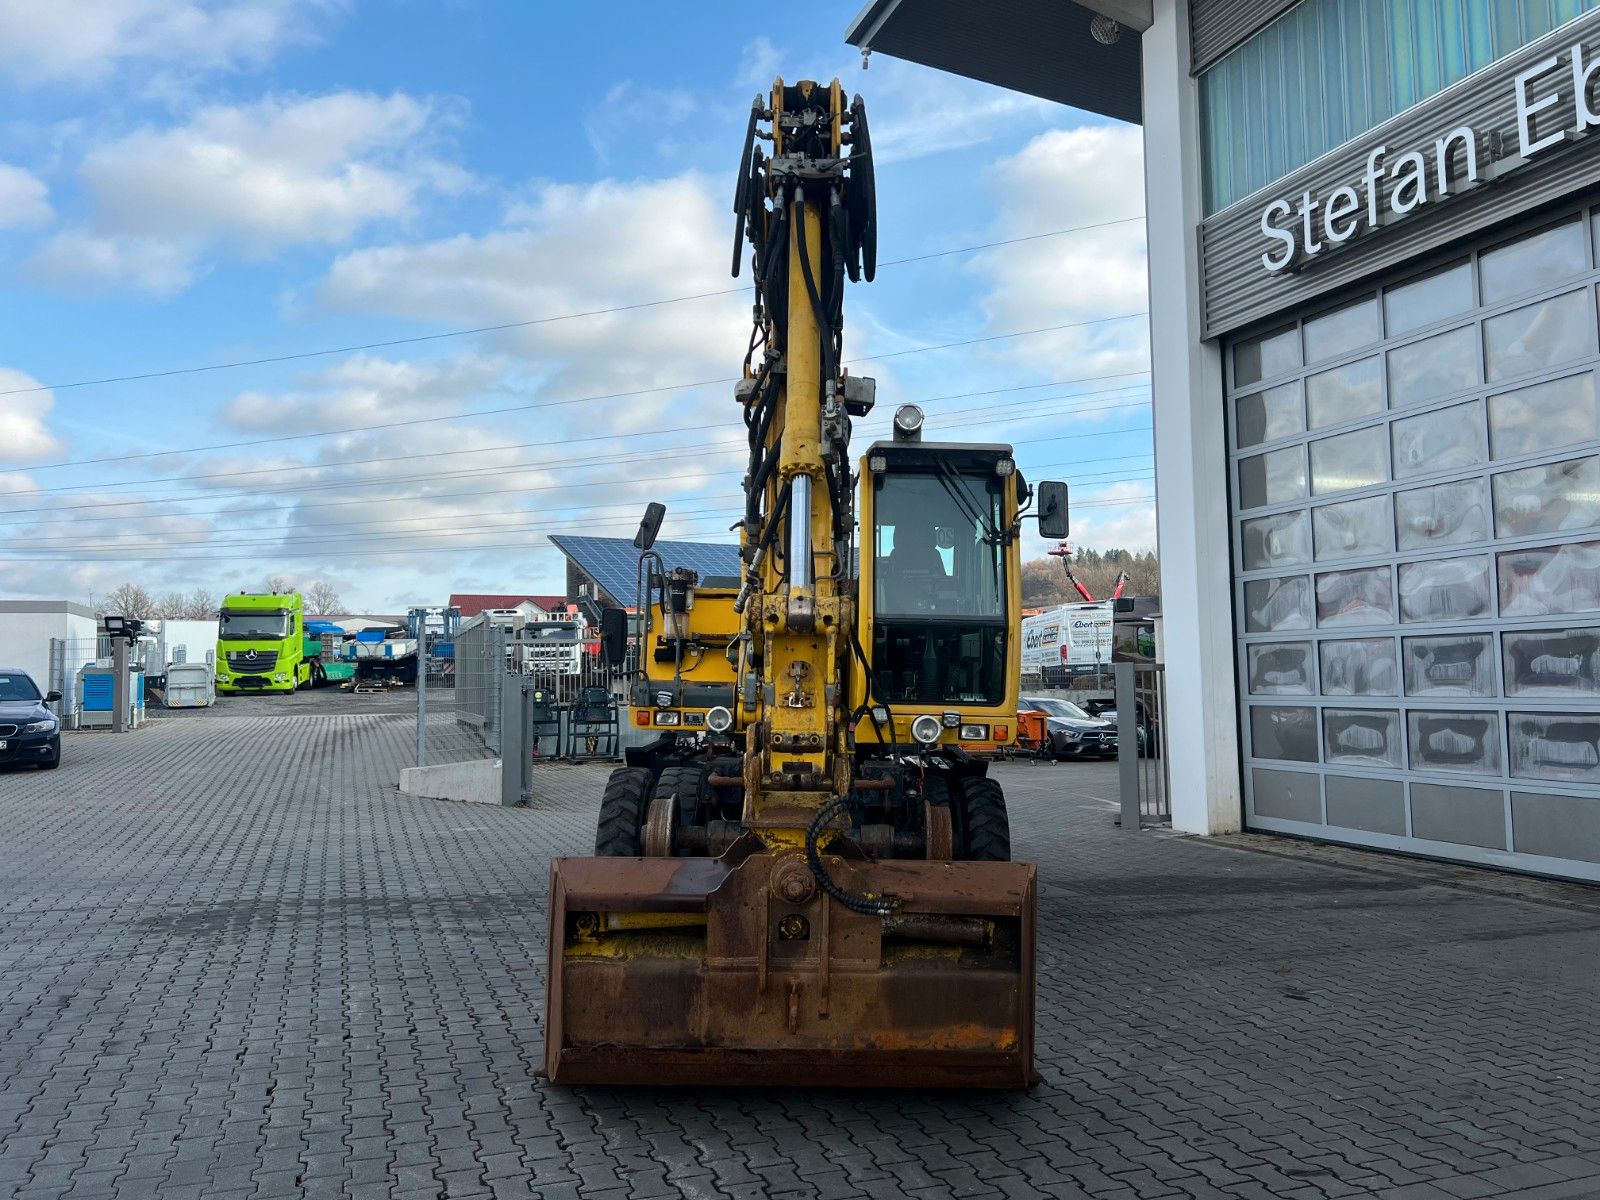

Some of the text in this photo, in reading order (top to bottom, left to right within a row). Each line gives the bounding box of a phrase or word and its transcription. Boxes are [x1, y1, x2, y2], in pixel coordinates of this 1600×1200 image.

[1261, 126, 1477, 271] Stefan
[1074, 620, 1093, 628] Ebert
[1026, 629, 1043, 650] Ebert
